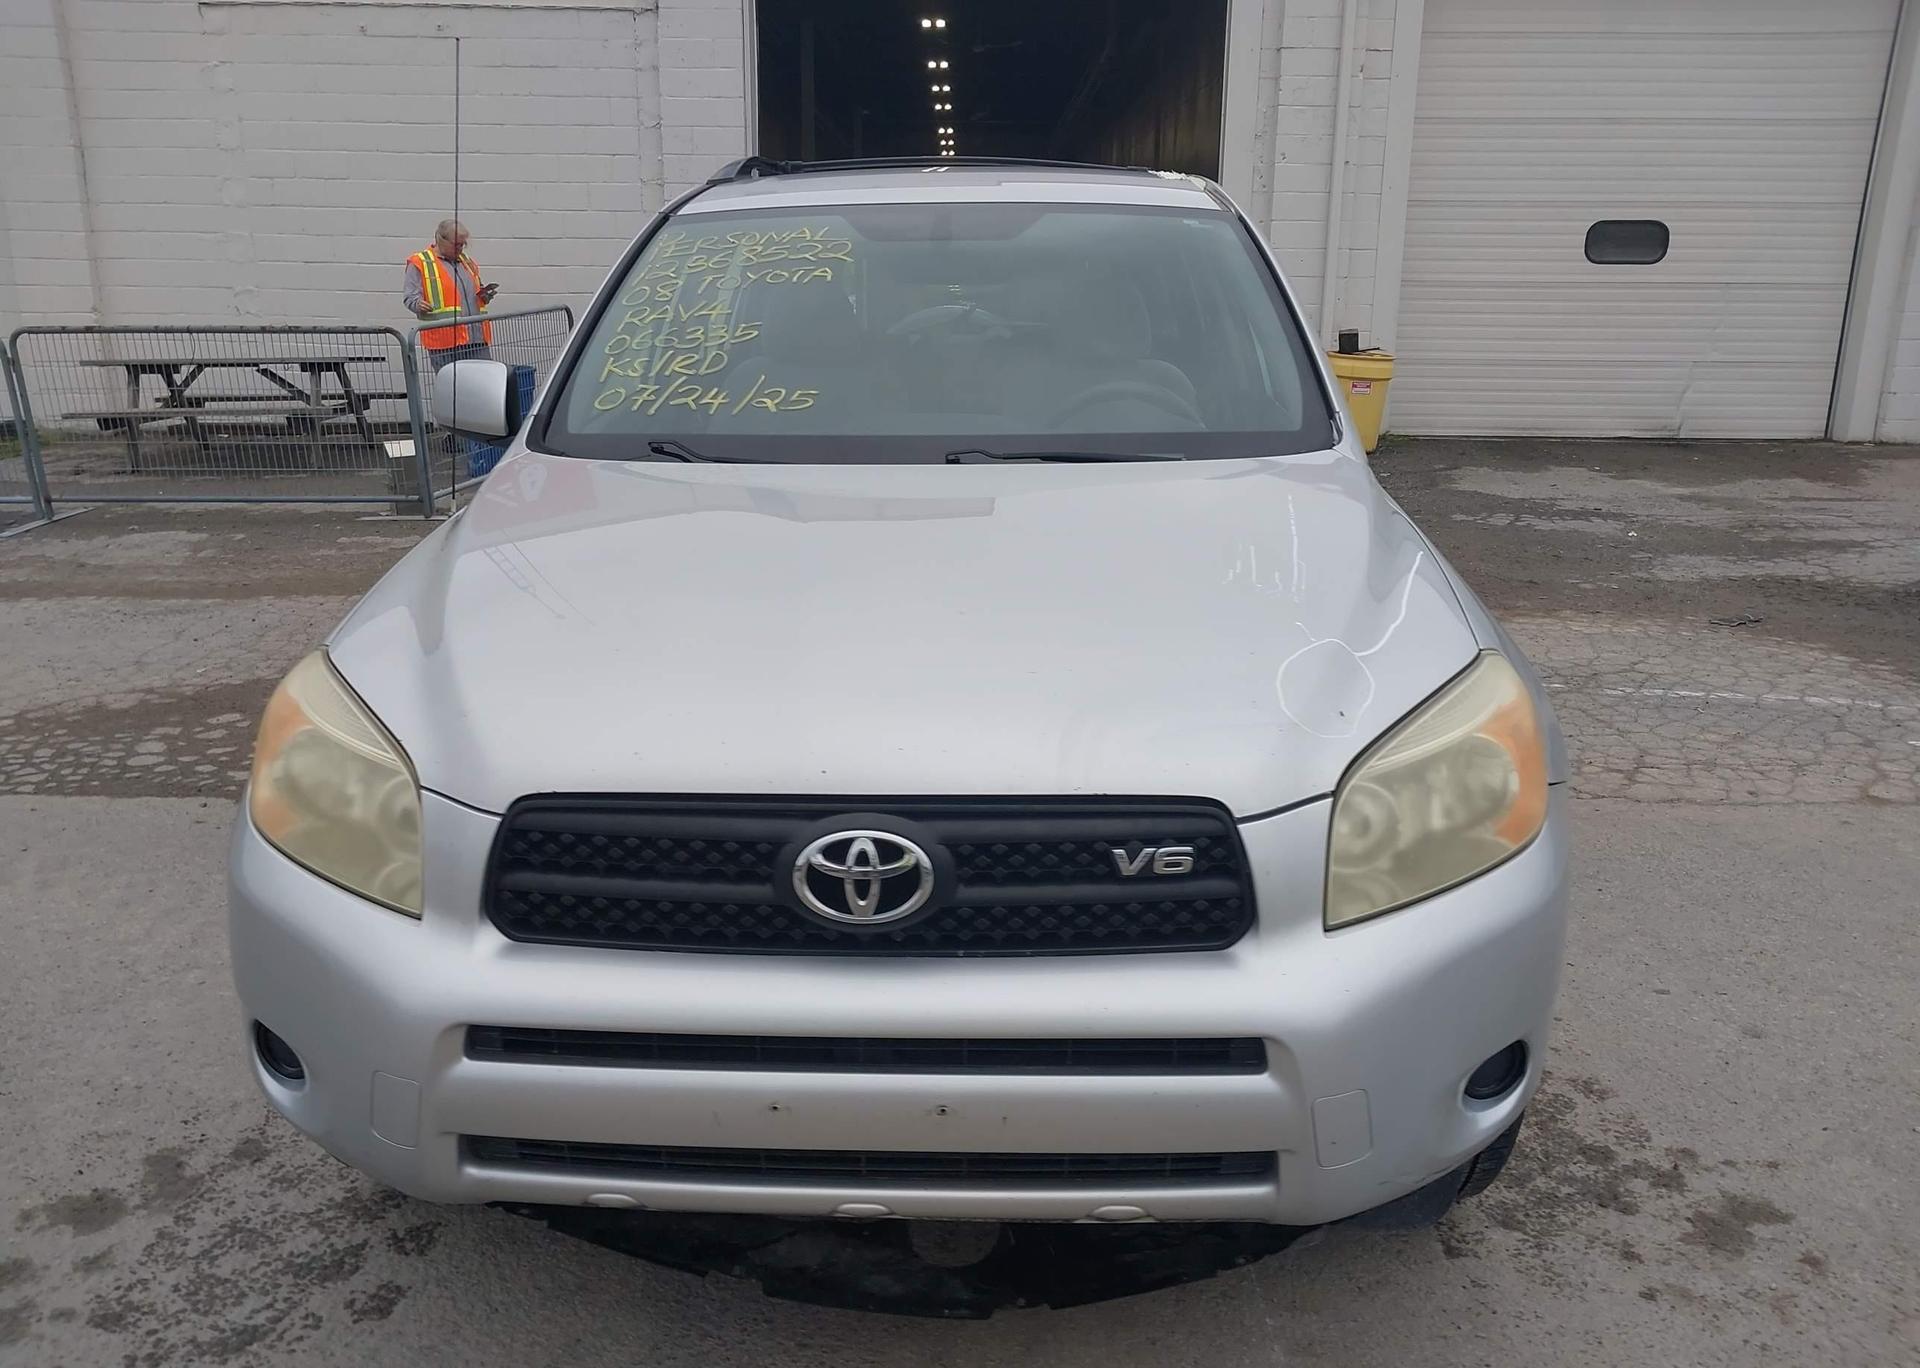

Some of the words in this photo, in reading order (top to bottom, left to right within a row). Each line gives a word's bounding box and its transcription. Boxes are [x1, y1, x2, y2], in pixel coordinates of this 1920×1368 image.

[649, 226, 849, 263] PERSONAL
[621, 280, 683, 306] 08
[697, 266, 834, 294] TOYOTA
[616, 299, 732, 332] RAV4
[593, 375, 820, 416] 07/24/25
[1111, 846, 1195, 876] V6
